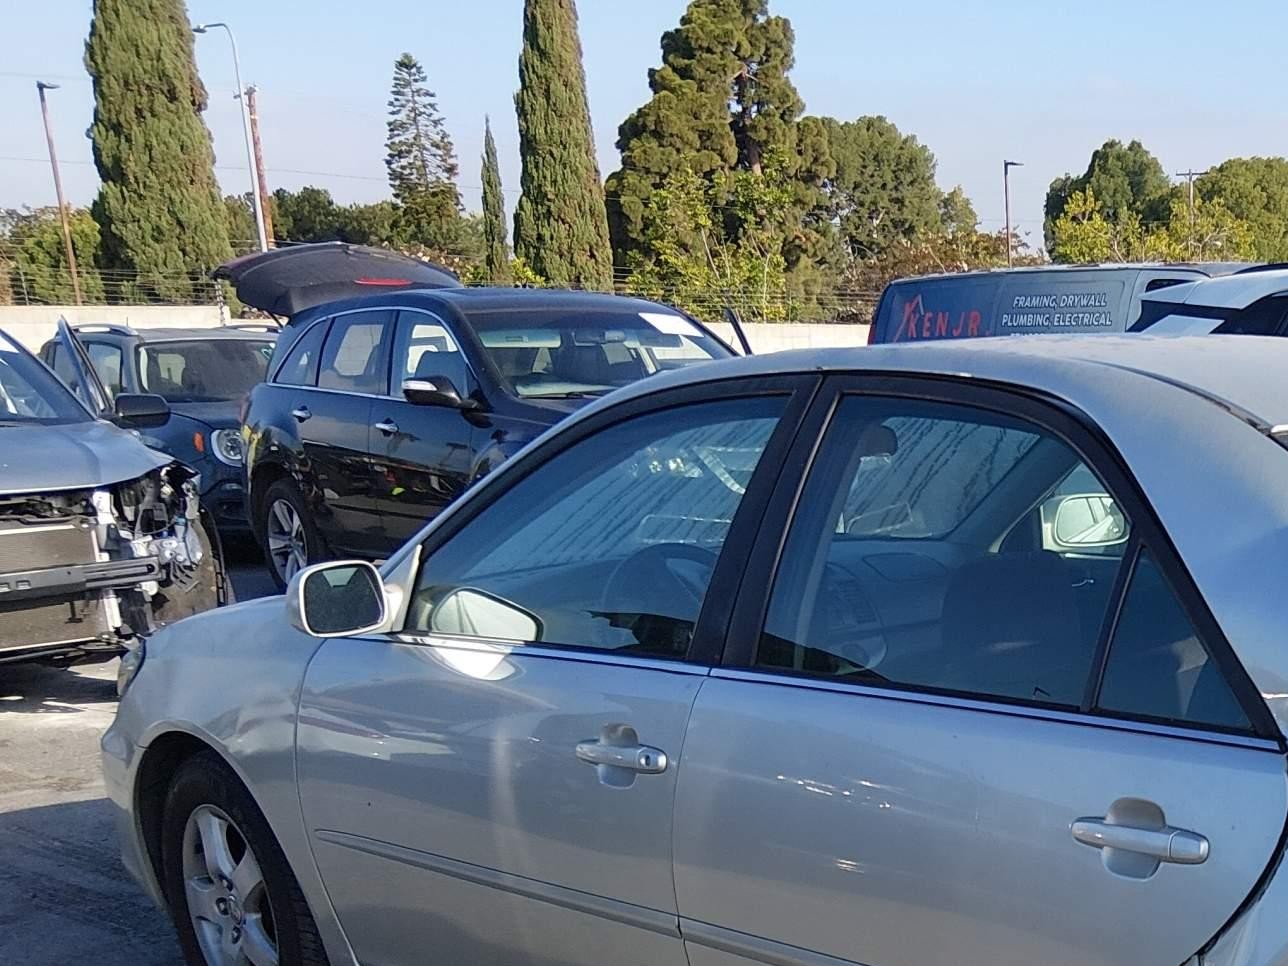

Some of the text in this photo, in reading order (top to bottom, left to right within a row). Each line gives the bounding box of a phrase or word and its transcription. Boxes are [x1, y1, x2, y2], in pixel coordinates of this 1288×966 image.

[1012, 293, 1107, 310] FRAMING, DRYWALL
[1001, 312, 1113, 329] PLUMBING, ELECTRICAL
